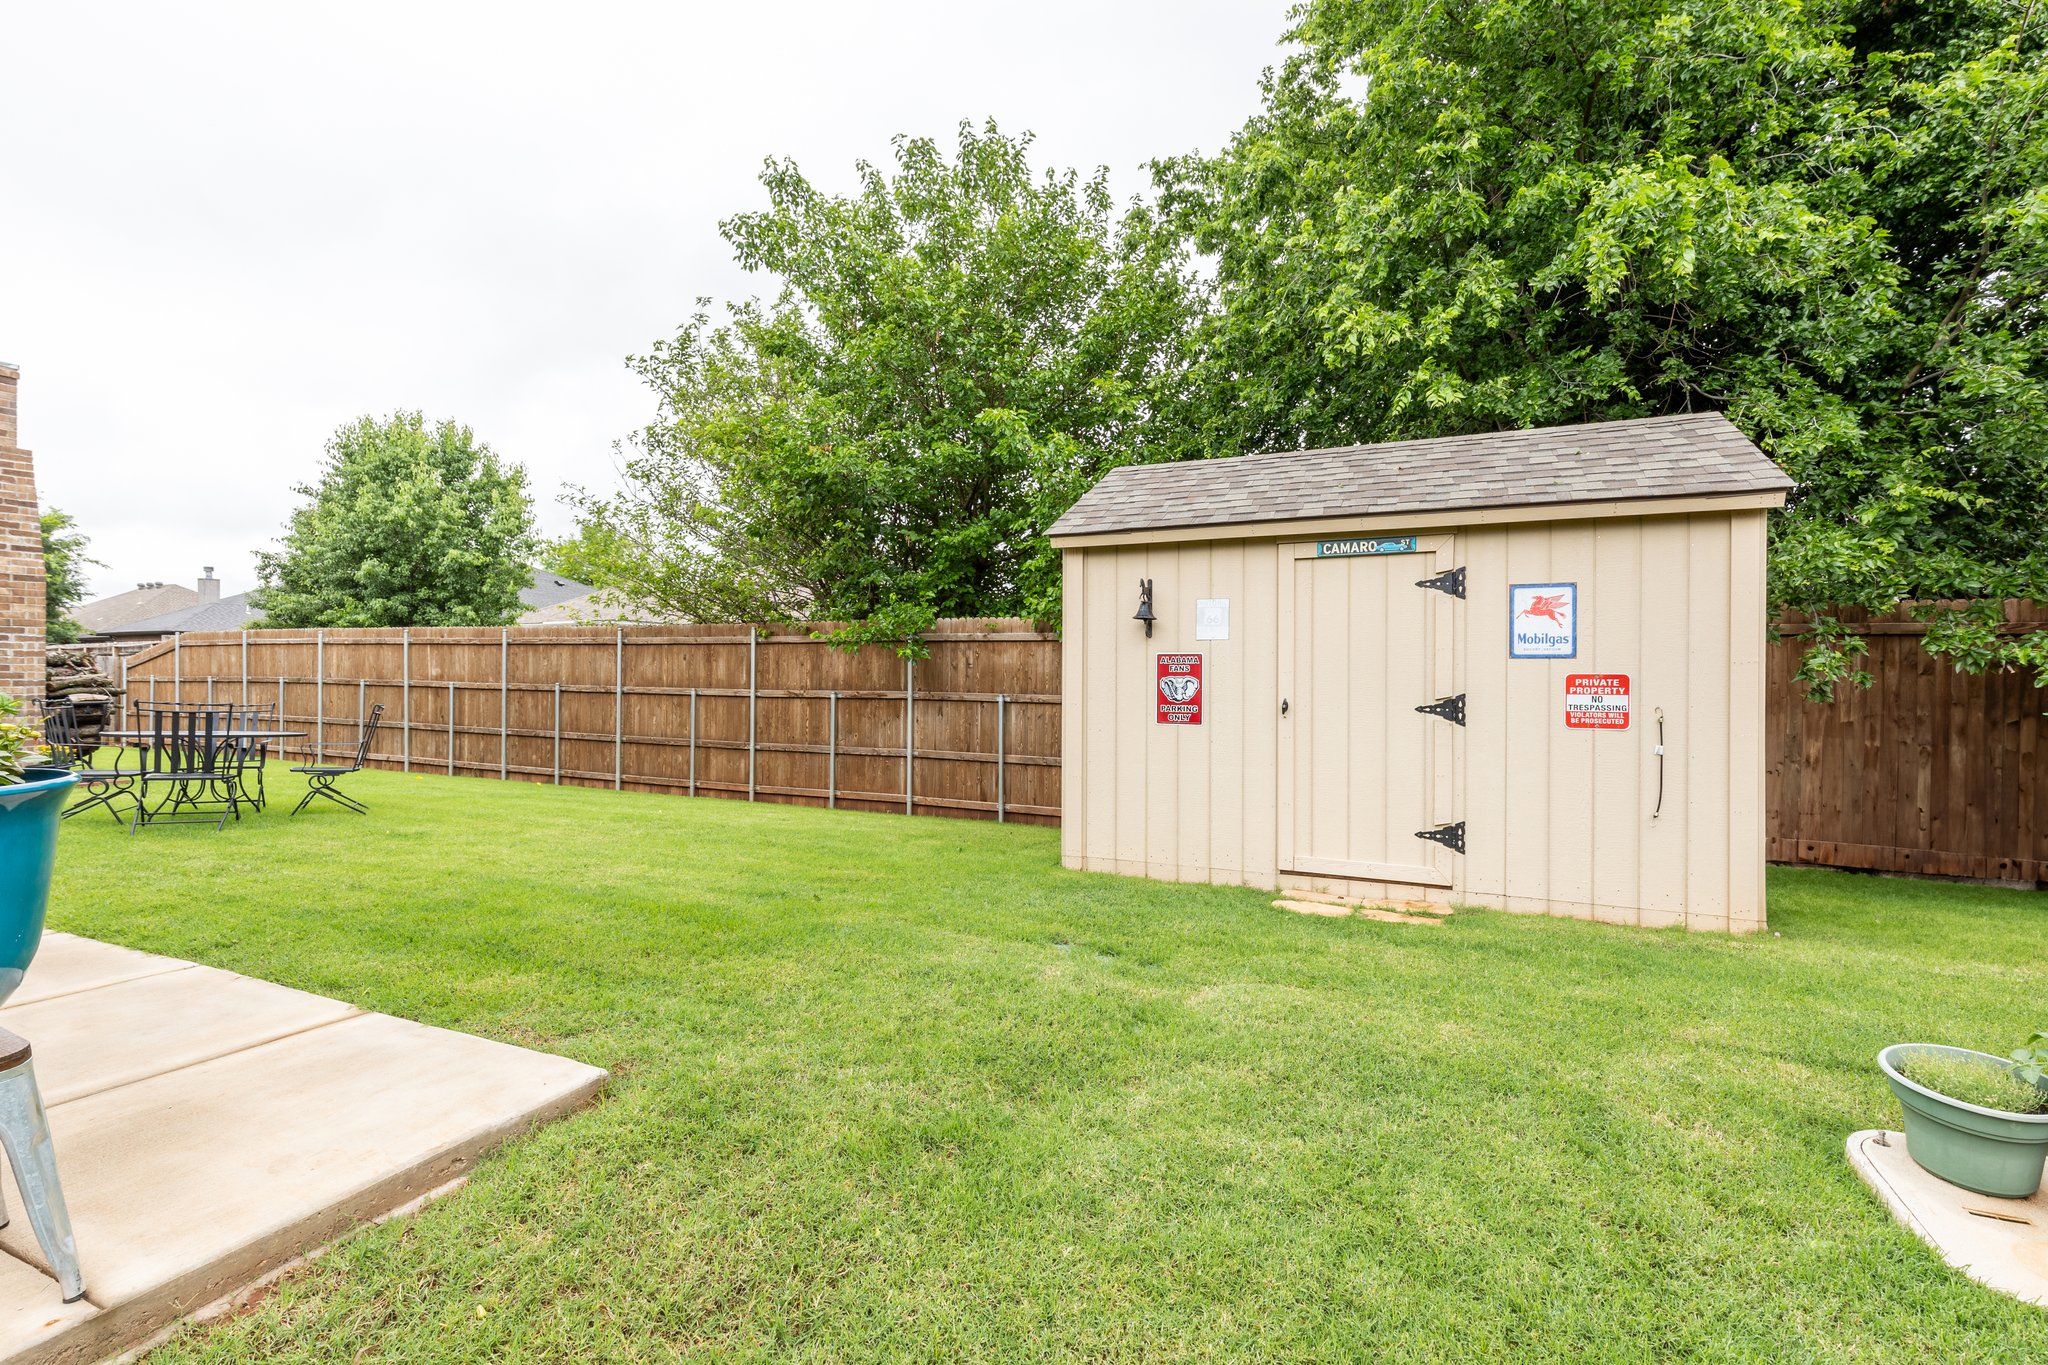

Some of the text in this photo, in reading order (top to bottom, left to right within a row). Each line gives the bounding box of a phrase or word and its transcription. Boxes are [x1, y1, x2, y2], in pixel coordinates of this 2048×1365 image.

[1323, 541, 1377, 554] CAMARO
[1206, 614, 1220, 624] 66
[1517, 633, 1569, 647] Mobilgas
[1160, 656, 1199, 664] ALABAMA
[1591, 695, 1603, 703] NO
[1160, 704, 1198, 713] PARKING
